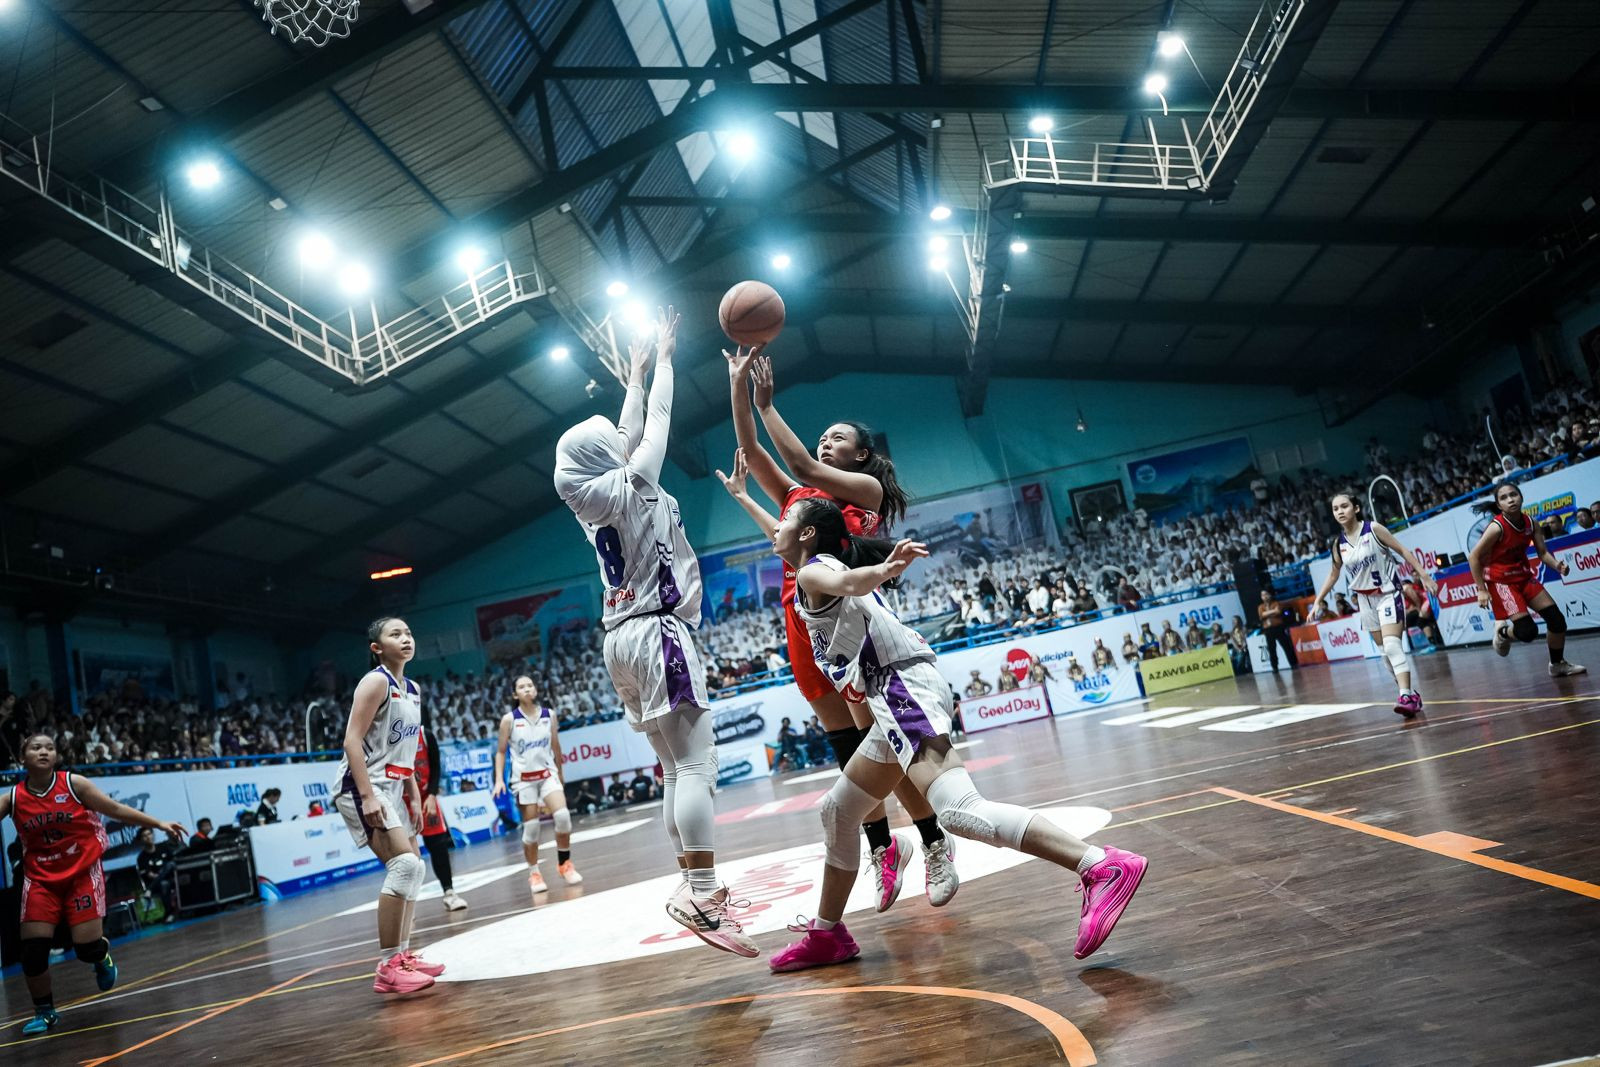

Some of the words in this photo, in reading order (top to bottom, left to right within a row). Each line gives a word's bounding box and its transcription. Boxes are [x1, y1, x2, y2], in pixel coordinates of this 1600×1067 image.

[595, 525, 625, 588] 8
[1371, 571, 1382, 586] 5
[1449, 583, 1478, 602] HON
[1178, 605, 1223, 627] AQUA
[1346, 628, 1360, 644] Da
[1039, 650, 1073, 662] dicipta
[1149, 662, 1200, 681] AZAWEAR
[1074, 672, 1110, 692] AQUA
[978, 702, 1013, 719] Good
[1013, 698, 1041, 712] Day
[888, 728, 904, 755] 3
[580, 743, 612, 760] Day
[227, 783, 260, 806] AQUA
[74, 895, 92, 911] 13
